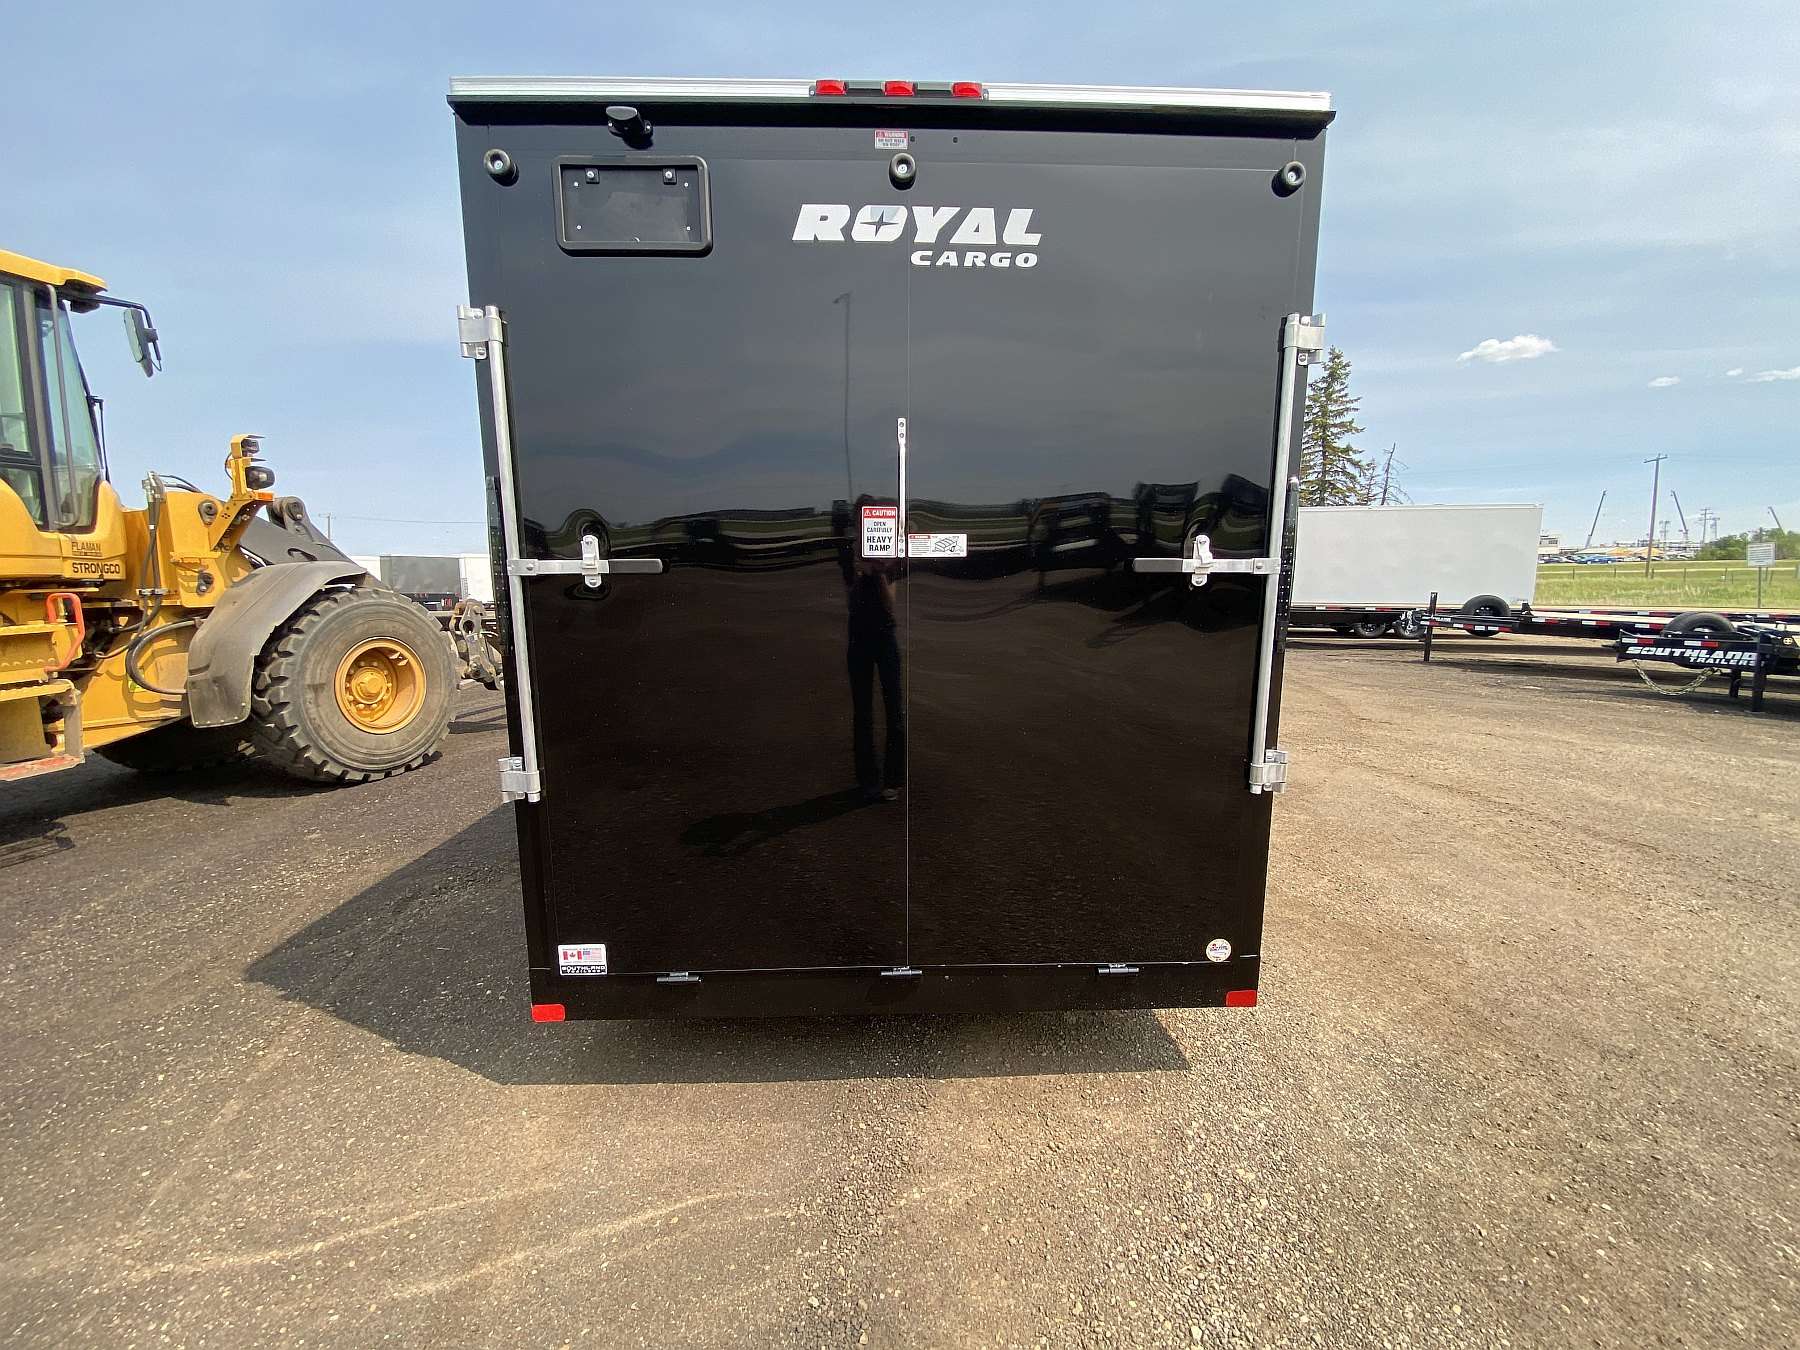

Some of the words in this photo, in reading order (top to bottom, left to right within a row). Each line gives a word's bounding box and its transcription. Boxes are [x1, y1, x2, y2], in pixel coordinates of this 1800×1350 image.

[792, 204, 1042, 245] ROYAL
[910, 250, 1038, 268] CARGO
[72, 541, 101, 551] FLAMAN
[869, 544, 891, 552] RAMP
[72, 562, 121, 574] STRONGCO
[1625, 646, 1758, 661] SOUTHLAND
[1689, 656, 1757, 667] TRAILERS
